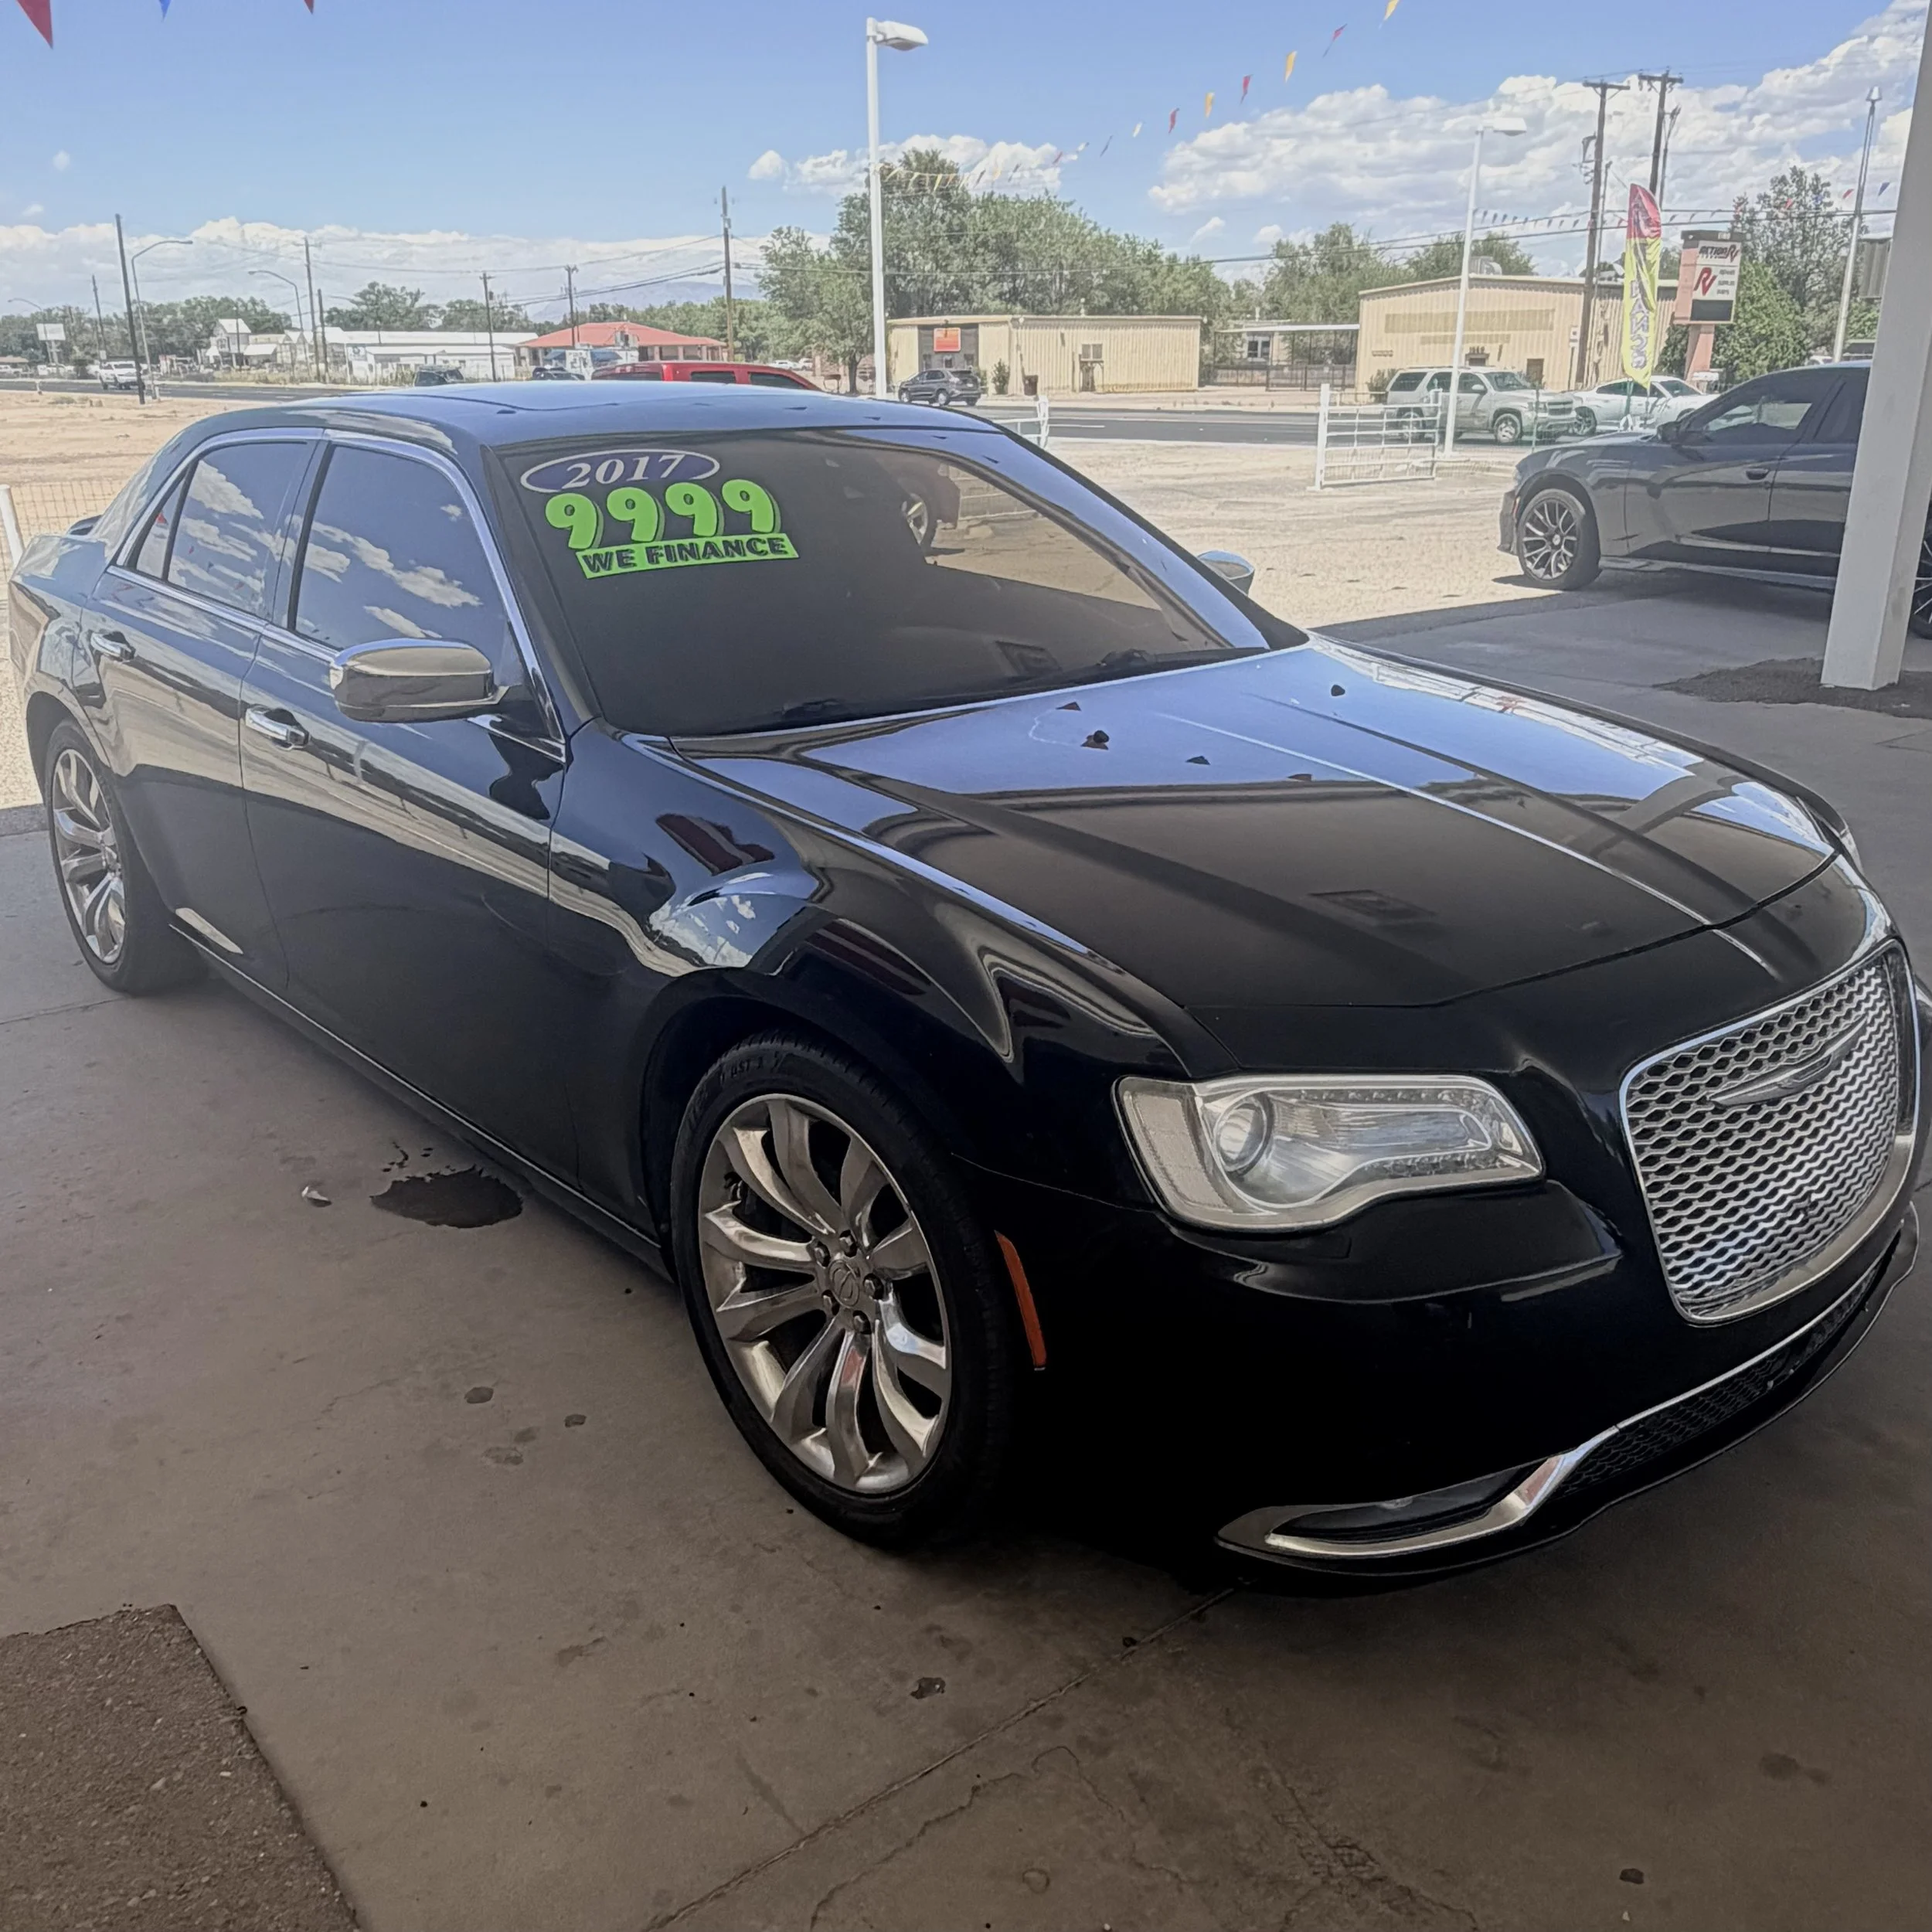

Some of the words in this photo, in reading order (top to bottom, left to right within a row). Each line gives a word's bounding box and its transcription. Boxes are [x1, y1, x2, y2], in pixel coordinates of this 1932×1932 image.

[561, 454, 685, 490] 2017
[545, 478, 781, 550] 9999
[581, 549, 636, 573] WE
[645, 536, 788, 565] FINANCE
